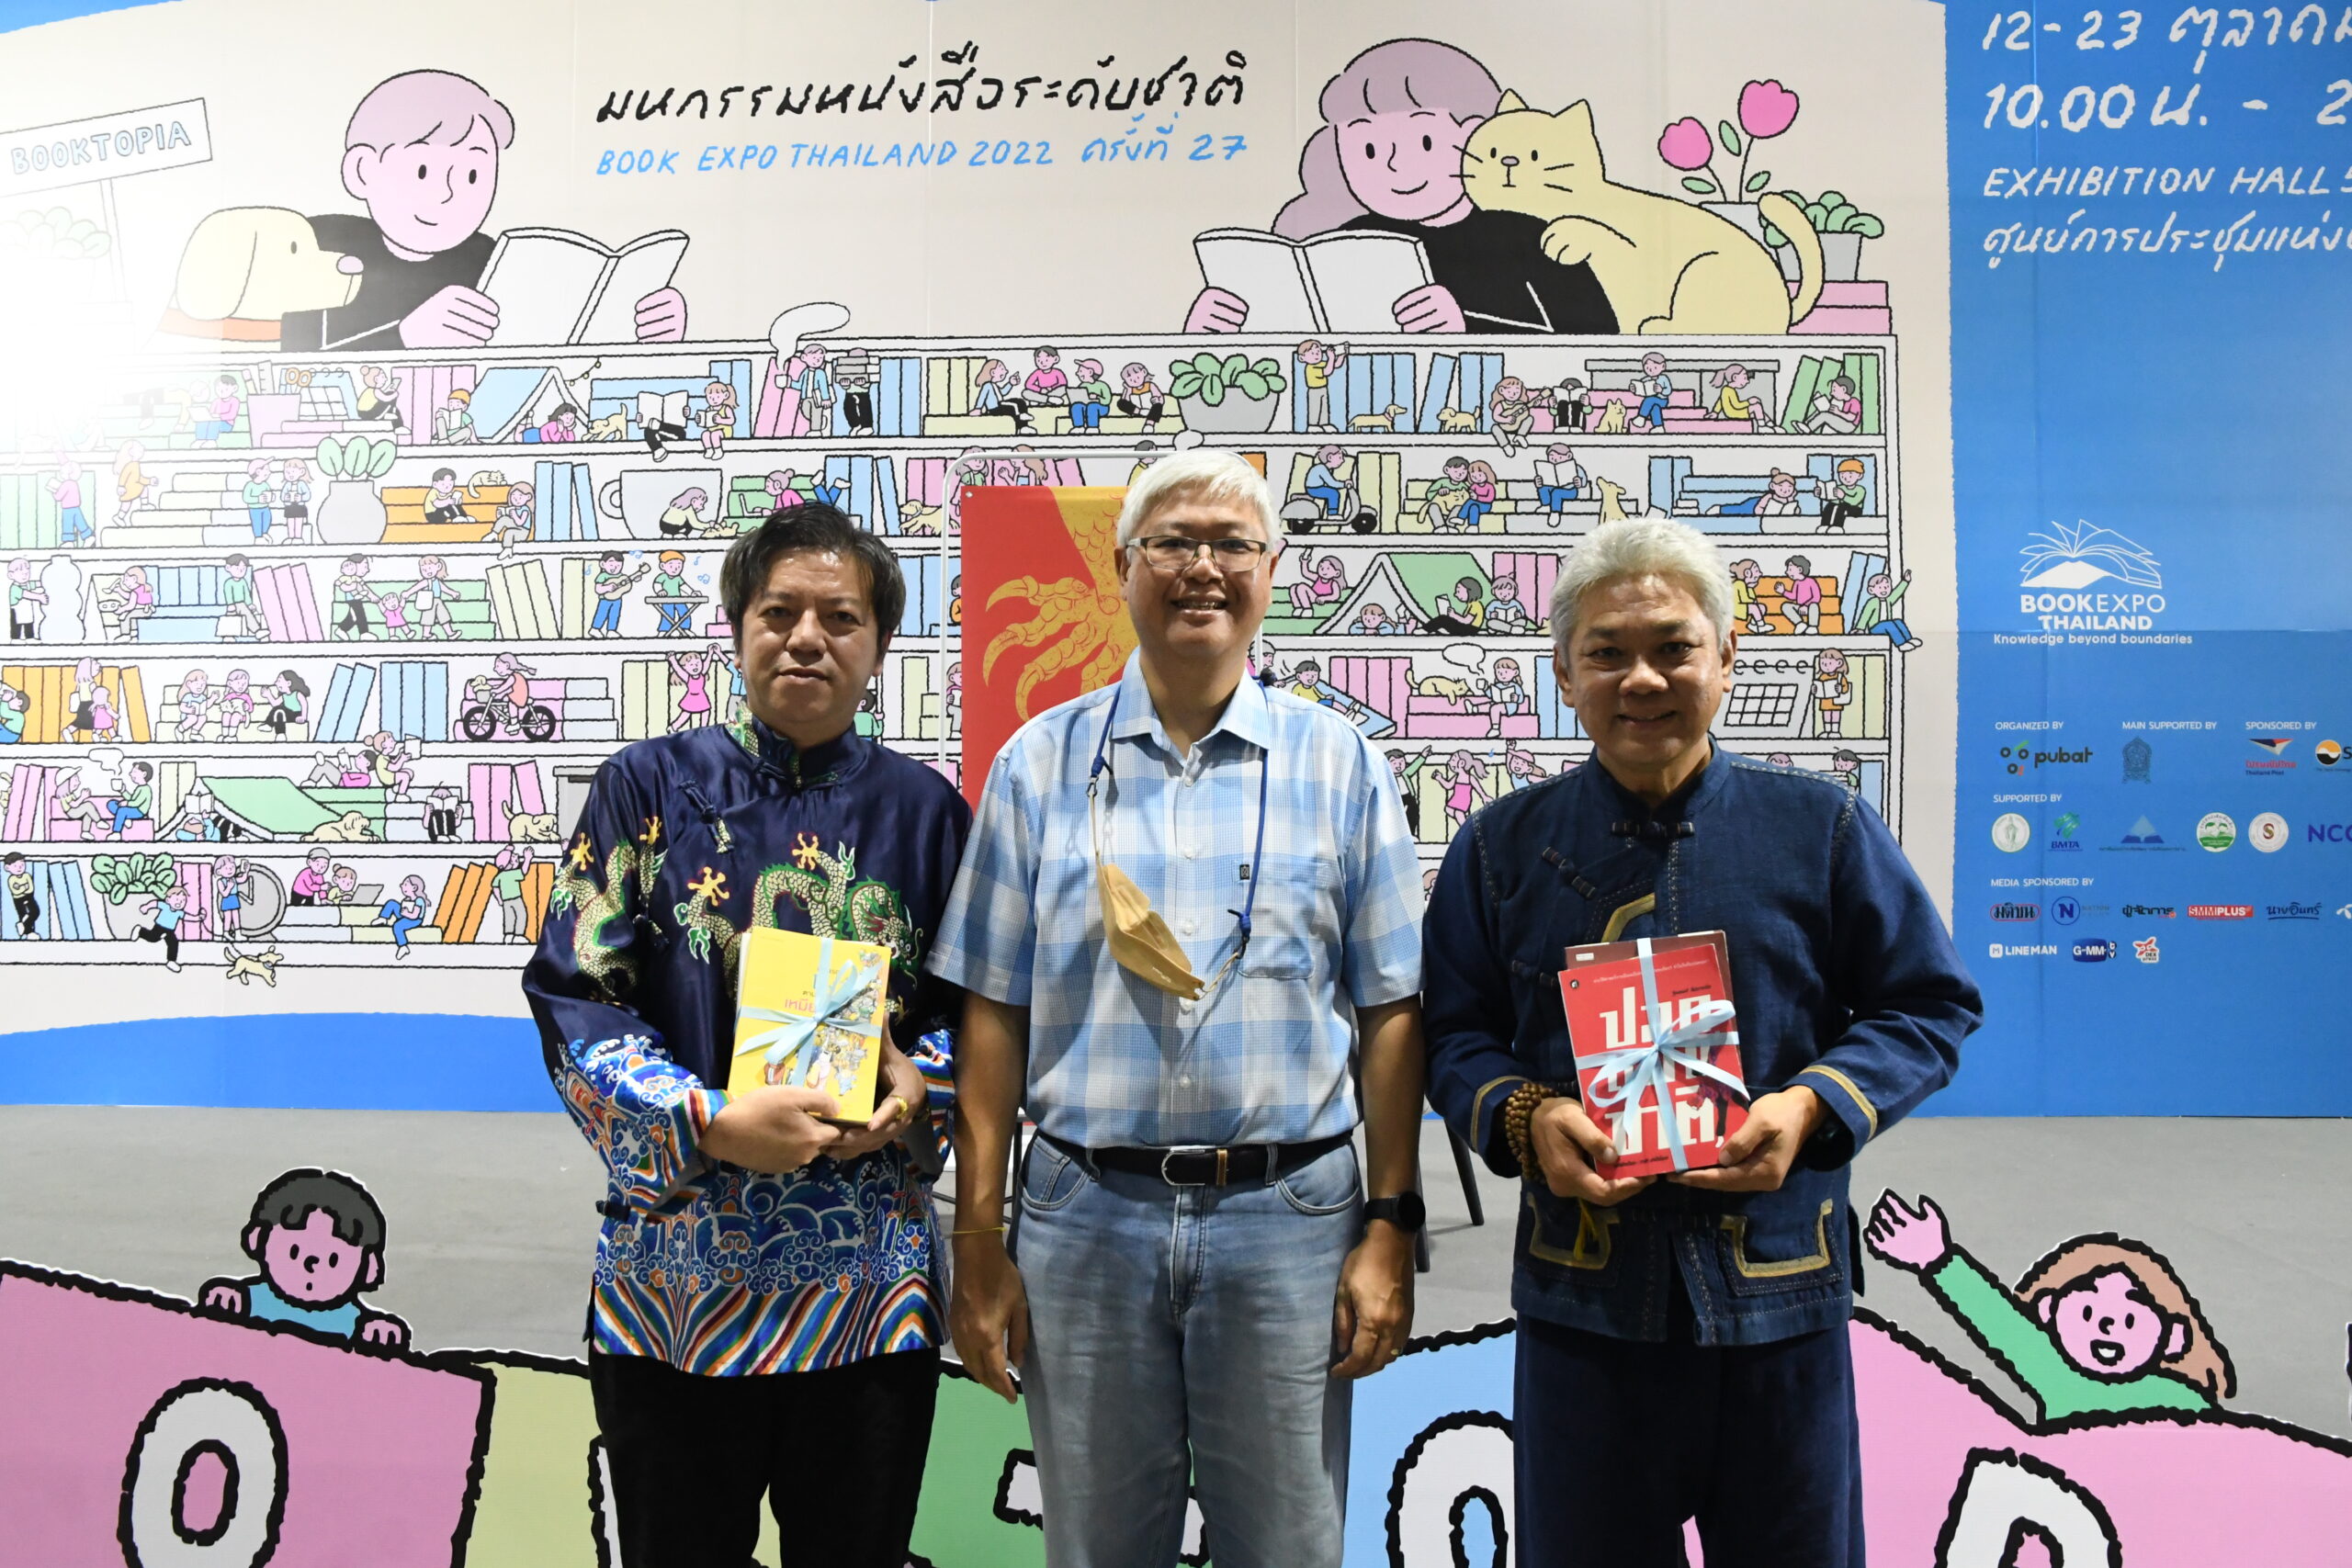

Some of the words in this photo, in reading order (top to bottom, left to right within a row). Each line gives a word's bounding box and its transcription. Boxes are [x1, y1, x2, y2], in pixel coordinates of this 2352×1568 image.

[596, 40, 1248, 123] มหกรรมหนังสือระดับชาติ
[1984, 83, 2136, 133] 10.00
[10, 120, 191, 175] BOOKTOPIA
[595, 148, 680, 175] BOOK
[696, 144, 778, 172] EXPO
[790, 140, 957, 168] THAILAND
[967, 140, 1054, 167] 2022
[1188, 133, 1248, 162] 27
[1983, 165, 2215, 199] EXHIBITION
[2230, 166, 2330, 195] HALL
[1983, 209, 2352, 273] ศูนย์การประชุมแห่ง
[2037, 615, 2154, 631] THAILAND
[1994, 633, 2064, 647] Knowledge
[2068, 633, 2117, 646] beyond
[2120, 633, 2193, 645] boundaries
[1995, 721, 2050, 730] ORGANIZED
[2052, 721, 2064, 729] BY
[2122, 721, 2146, 730] MAIN
[2148, 721, 2203, 730] SUPPORTED
[2205, 721, 2218, 730] BY
[2245, 721, 2302, 730] SPONSORED
[2304, 721, 2316, 730] BY
[2034, 747, 2094, 769] pubat
[1993, 794, 2048, 804] SUPPORTED
[2050, 794, 2063, 803] BY
[2051, 840, 2080, 850] BMTA
[1991, 877, 2020, 887] MEDIA
[2023, 877, 2080, 887] SPONSORED
[2082, 877, 2095, 886] BY
